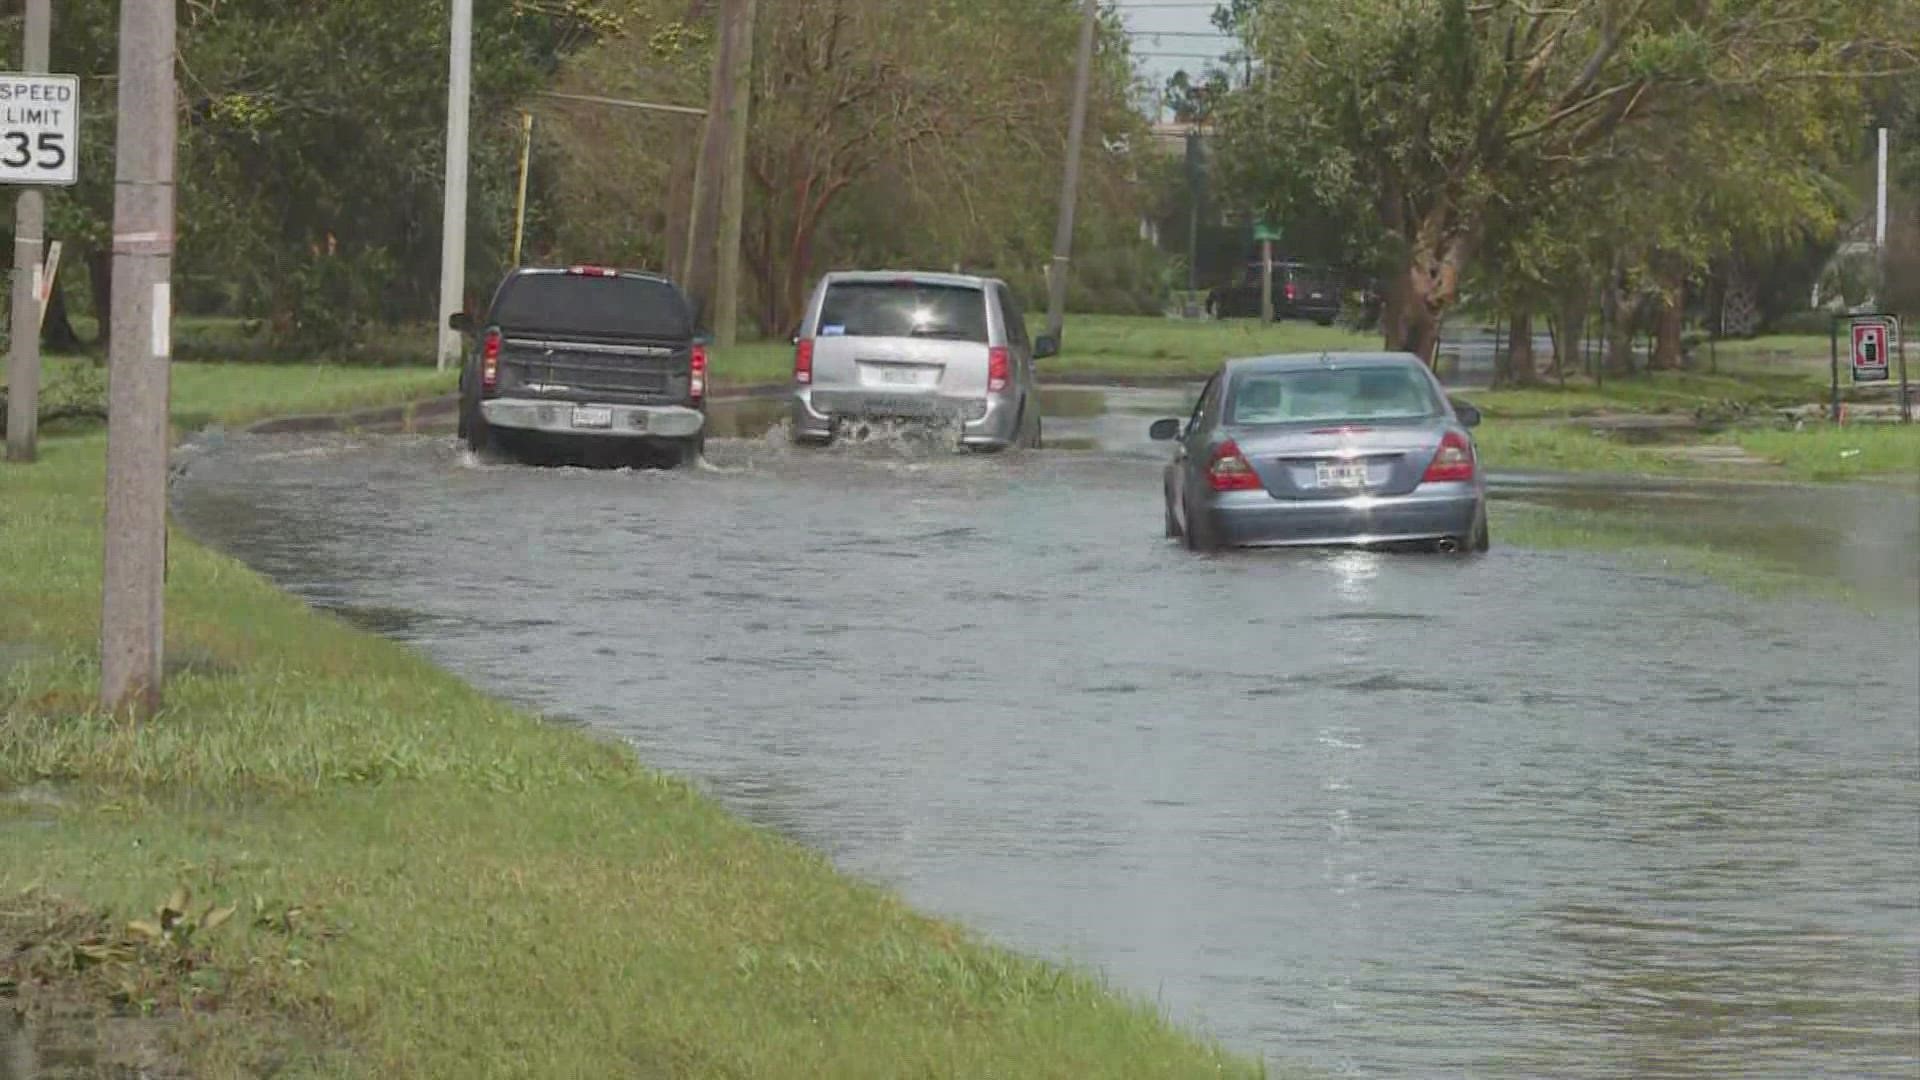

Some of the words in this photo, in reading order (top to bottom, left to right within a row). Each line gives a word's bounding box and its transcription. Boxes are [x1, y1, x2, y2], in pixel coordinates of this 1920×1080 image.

[0, 83, 71, 101] SPEED
[7, 107, 61, 125] LIMIT
[2, 131, 65, 170] 35
